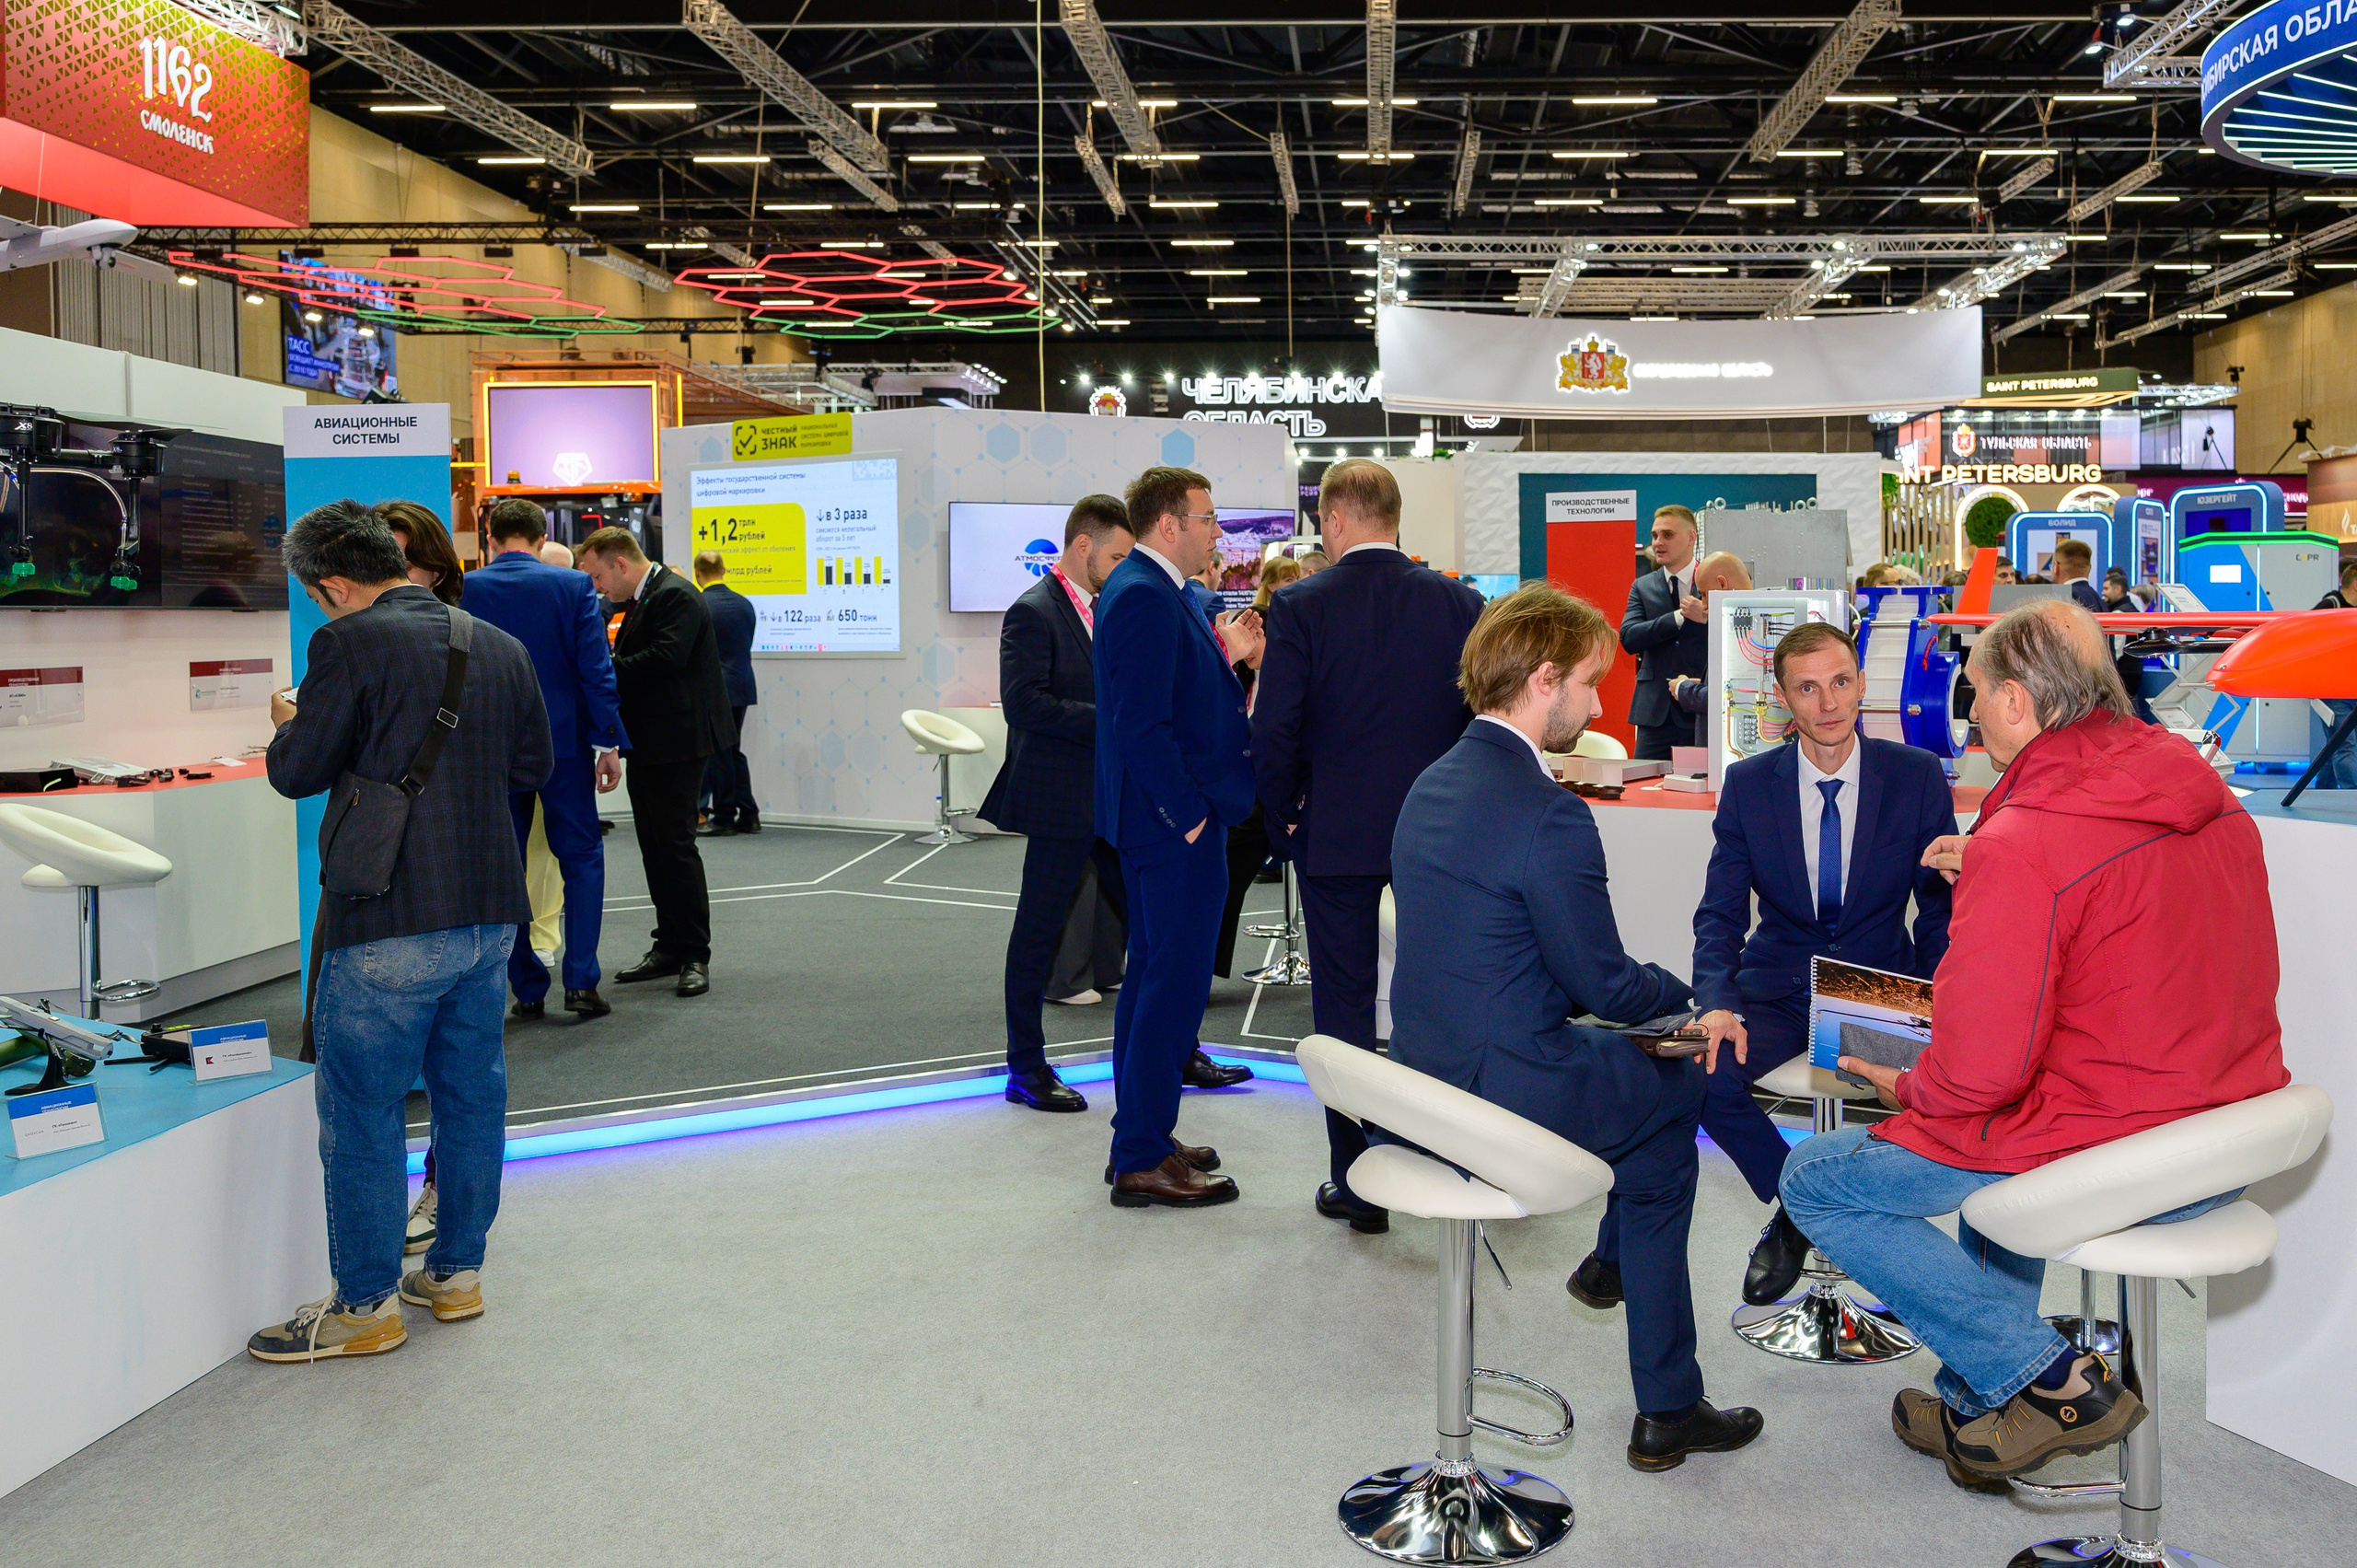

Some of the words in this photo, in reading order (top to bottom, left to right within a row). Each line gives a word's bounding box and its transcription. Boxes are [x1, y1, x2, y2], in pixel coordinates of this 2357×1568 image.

[139, 35, 213, 123] 1162
[140, 109, 215, 155] СМОЛЕНСК
[288, 336, 310, 354] ТАСС
[1181, 376, 1383, 404] ЧЕЛЯБИНСКА
[1986, 379, 2020, 393] SAINT
[2021, 376, 2099, 391] PETERSBURG
[314, 416, 418, 430] АВИАЦИОННЫЕ
[761, 424, 798, 435] ЧЕСТНЫЙ
[332, 433, 400, 445] СИСТЕМЫ
[761, 436, 797, 450] ЗНАК
[1980, 436, 2038, 450] ТУЛЬСКАЯ
[779, 472, 807, 481] системы
[1941, 464, 2102, 484] PETERSBURG
[1551, 498, 1630, 506] ПРОИЗВОДСТВЕННЫЕ
[834, 507, 840, 518] 3
[843, 508, 867, 523] раза
[2048, 519, 2077, 528] БОЛИД
[739, 531, 765, 542] рублей
[784, 610, 803, 622] 122
[805, 615, 822, 624] раза
[838, 609, 857, 621] 650
